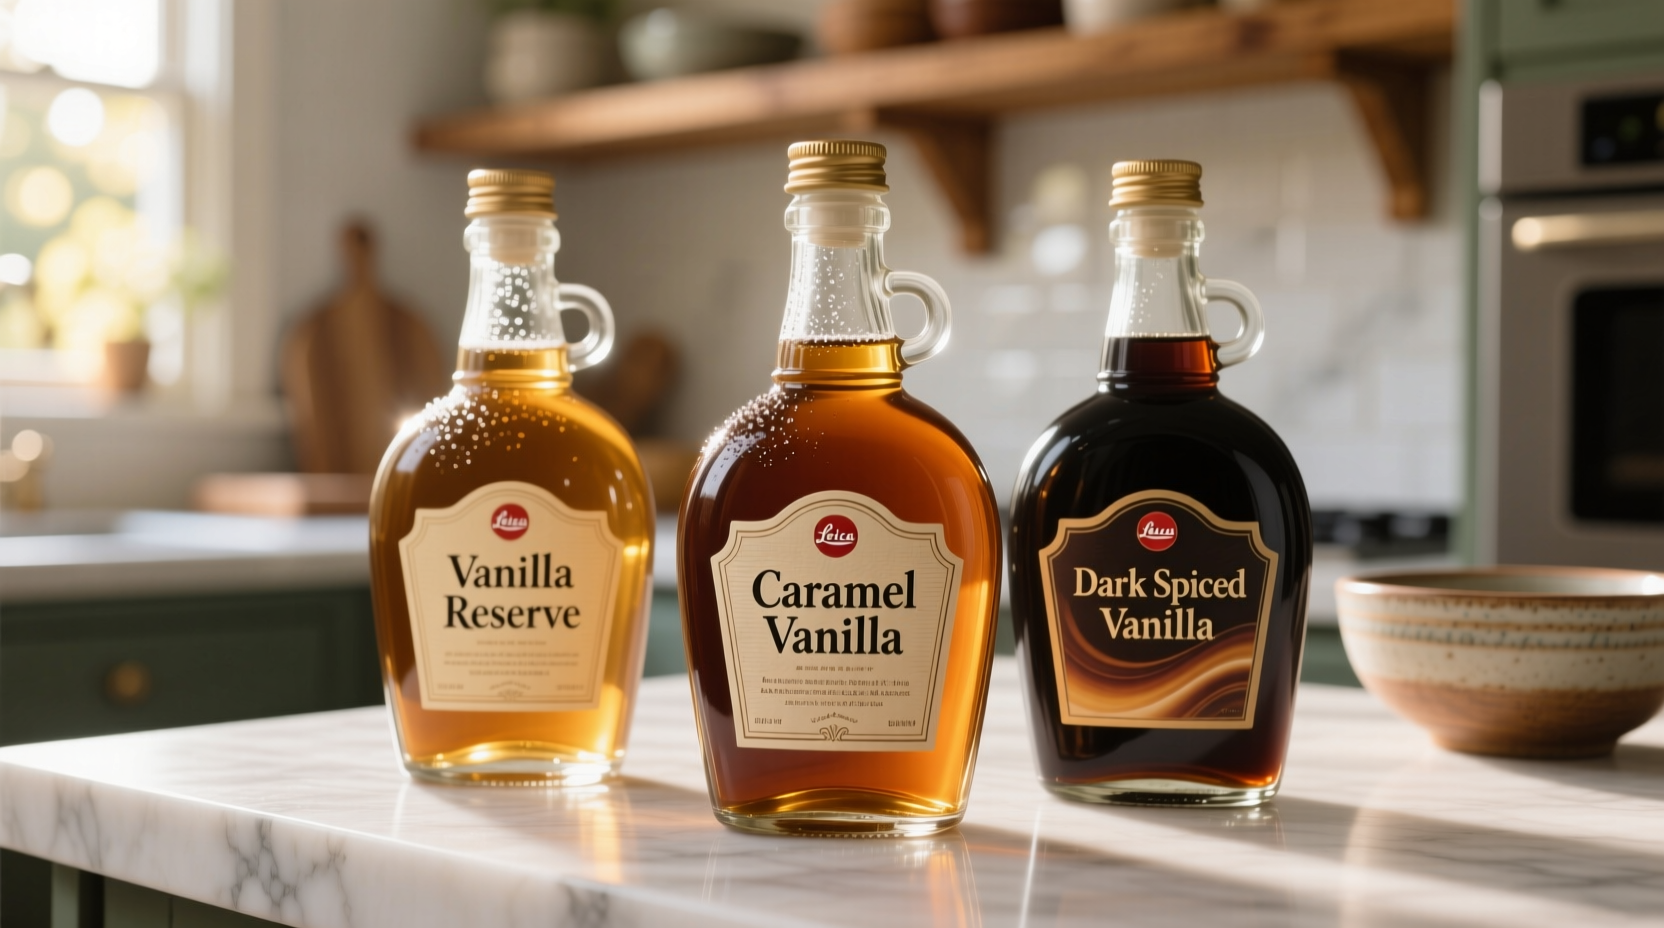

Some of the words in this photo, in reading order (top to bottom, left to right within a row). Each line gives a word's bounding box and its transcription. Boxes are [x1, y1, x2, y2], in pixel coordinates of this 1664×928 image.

[448, 552, 574, 588] Vanilla
[1073, 567, 1147, 597] Dark
[1153, 568, 1247, 606] Spiced
[752, 569, 917, 609] Caramel
[444, 594, 581, 629] Reserve
[1099, 607, 1215, 641] Vanilla
[763, 615, 904, 655] Vanilla
